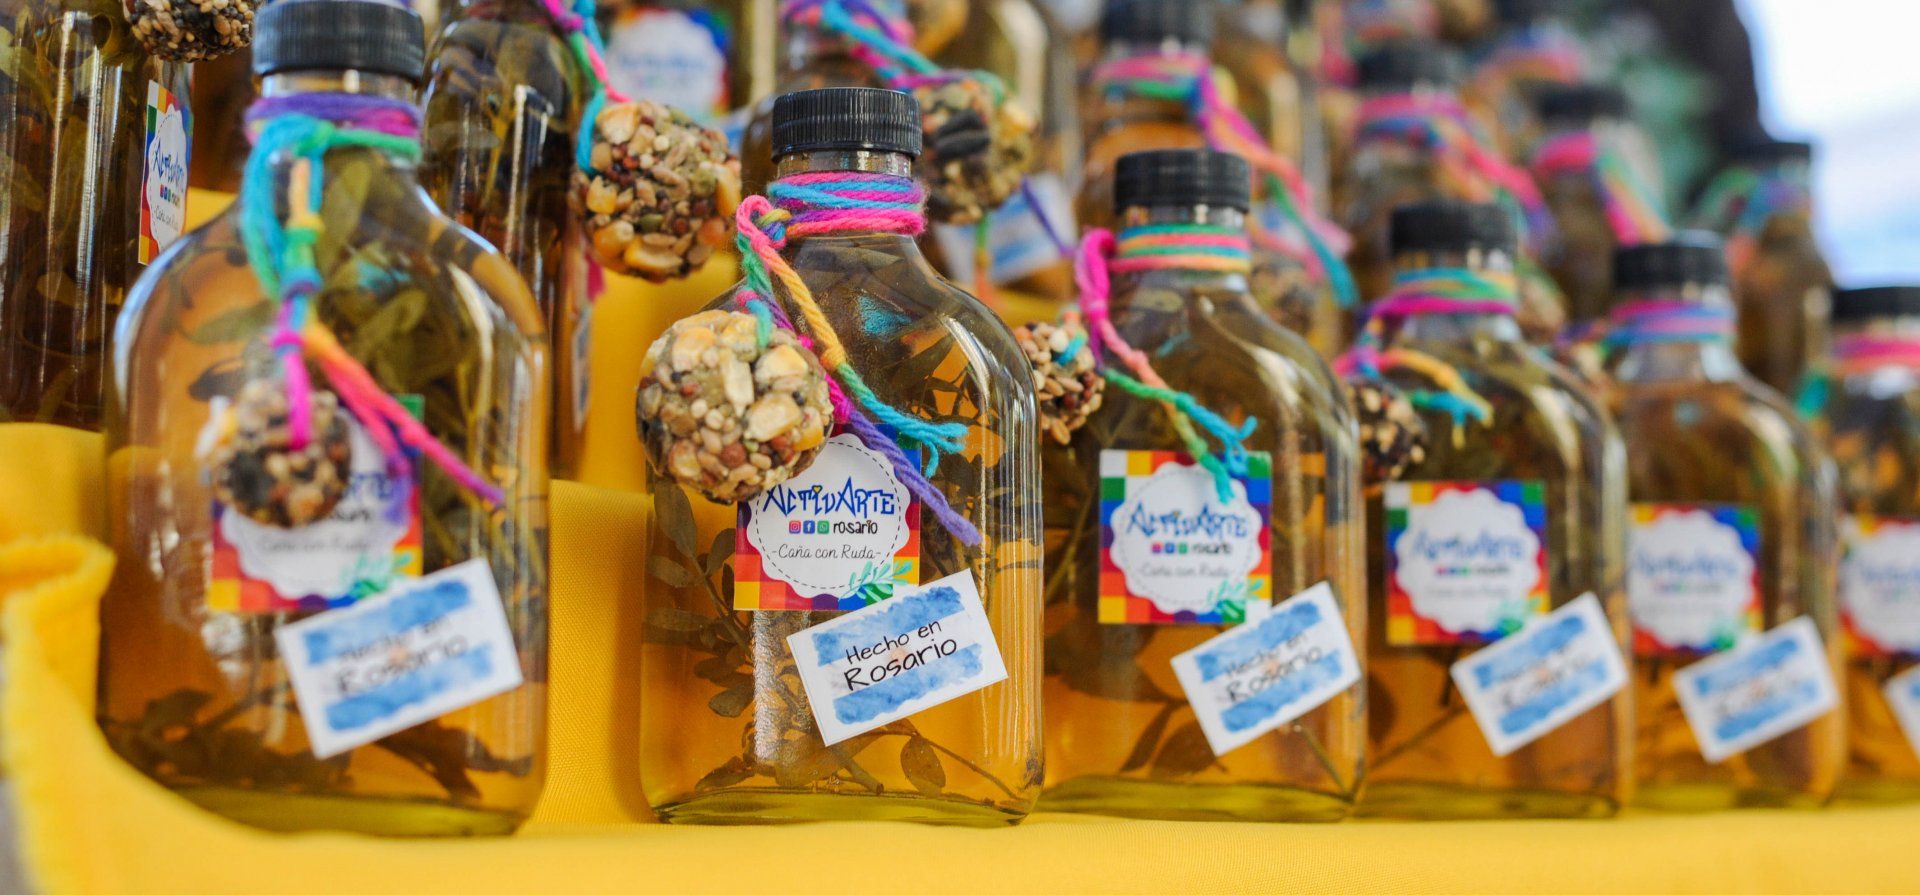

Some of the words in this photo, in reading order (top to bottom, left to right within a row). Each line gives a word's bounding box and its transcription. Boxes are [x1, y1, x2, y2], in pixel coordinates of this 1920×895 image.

[832, 520, 878, 534] rosario
[814, 547, 837, 559] con
[845, 632, 910, 665] Hecho
[917, 620, 943, 639] en
[843, 638, 958, 691] Rosario
